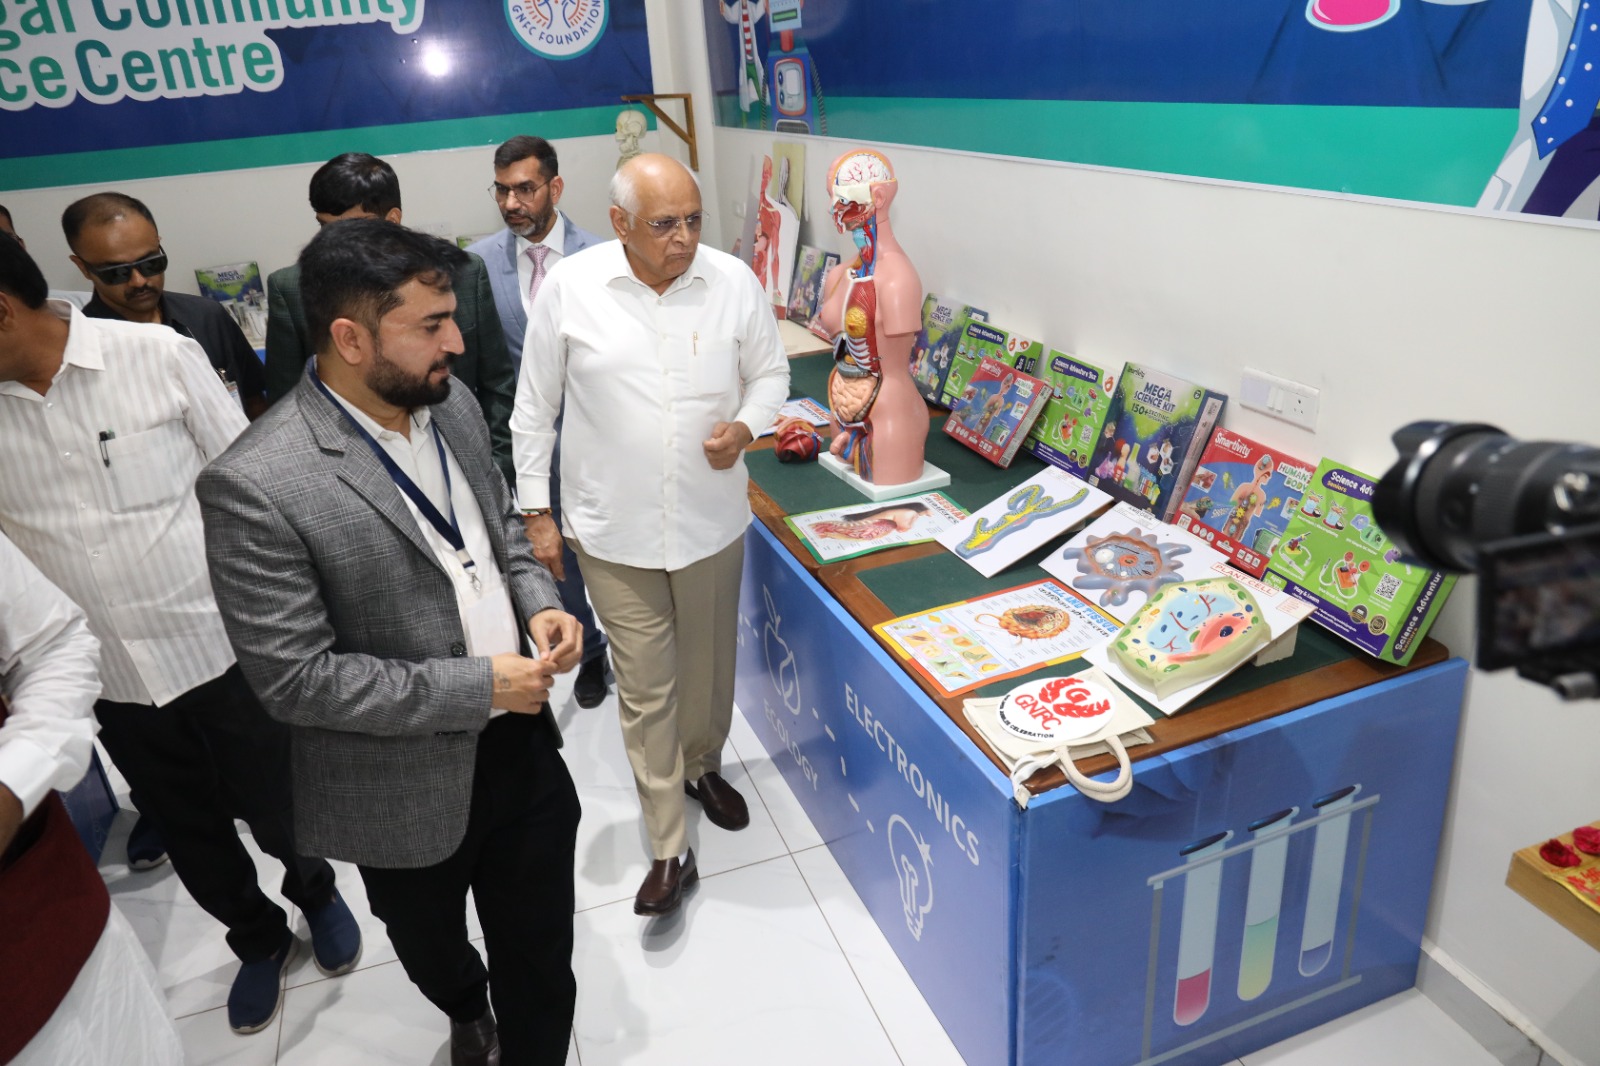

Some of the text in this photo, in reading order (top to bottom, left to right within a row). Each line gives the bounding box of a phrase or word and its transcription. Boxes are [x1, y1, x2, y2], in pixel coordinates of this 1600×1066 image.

[92, 0, 418, 31] Commuy
[511, 0, 601, 45] GNFC FOUNDATION
[75, 37, 276, 96] Centre
[1133, 390, 1177, 413] SCIENCE KIT
[1143, 382, 1173, 402] MEGA
[1131, 403, 1149, 415] 150+
[1215, 433, 1251, 457] Smartivity
[1279, 464, 1310, 481] HUMAN
[1286, 476, 1307, 492] BODY
[1330, 471, 1358, 489] Science
[1327, 480, 1347, 493] Seniors
[1215, 564, 1247, 582] PLANT
[1247, 580, 1273, 596] CELL
[1043, 582, 1119, 634] CELL AND TISSUE
[1394, 615, 1419, 650] Science
[1014, 693, 1061, 731] GNFC
[1010, 723, 1054, 739] CELEBRATION
[764, 699, 818, 791] ECOLOGY
[845, 682, 979, 866] ELECTRONICS
